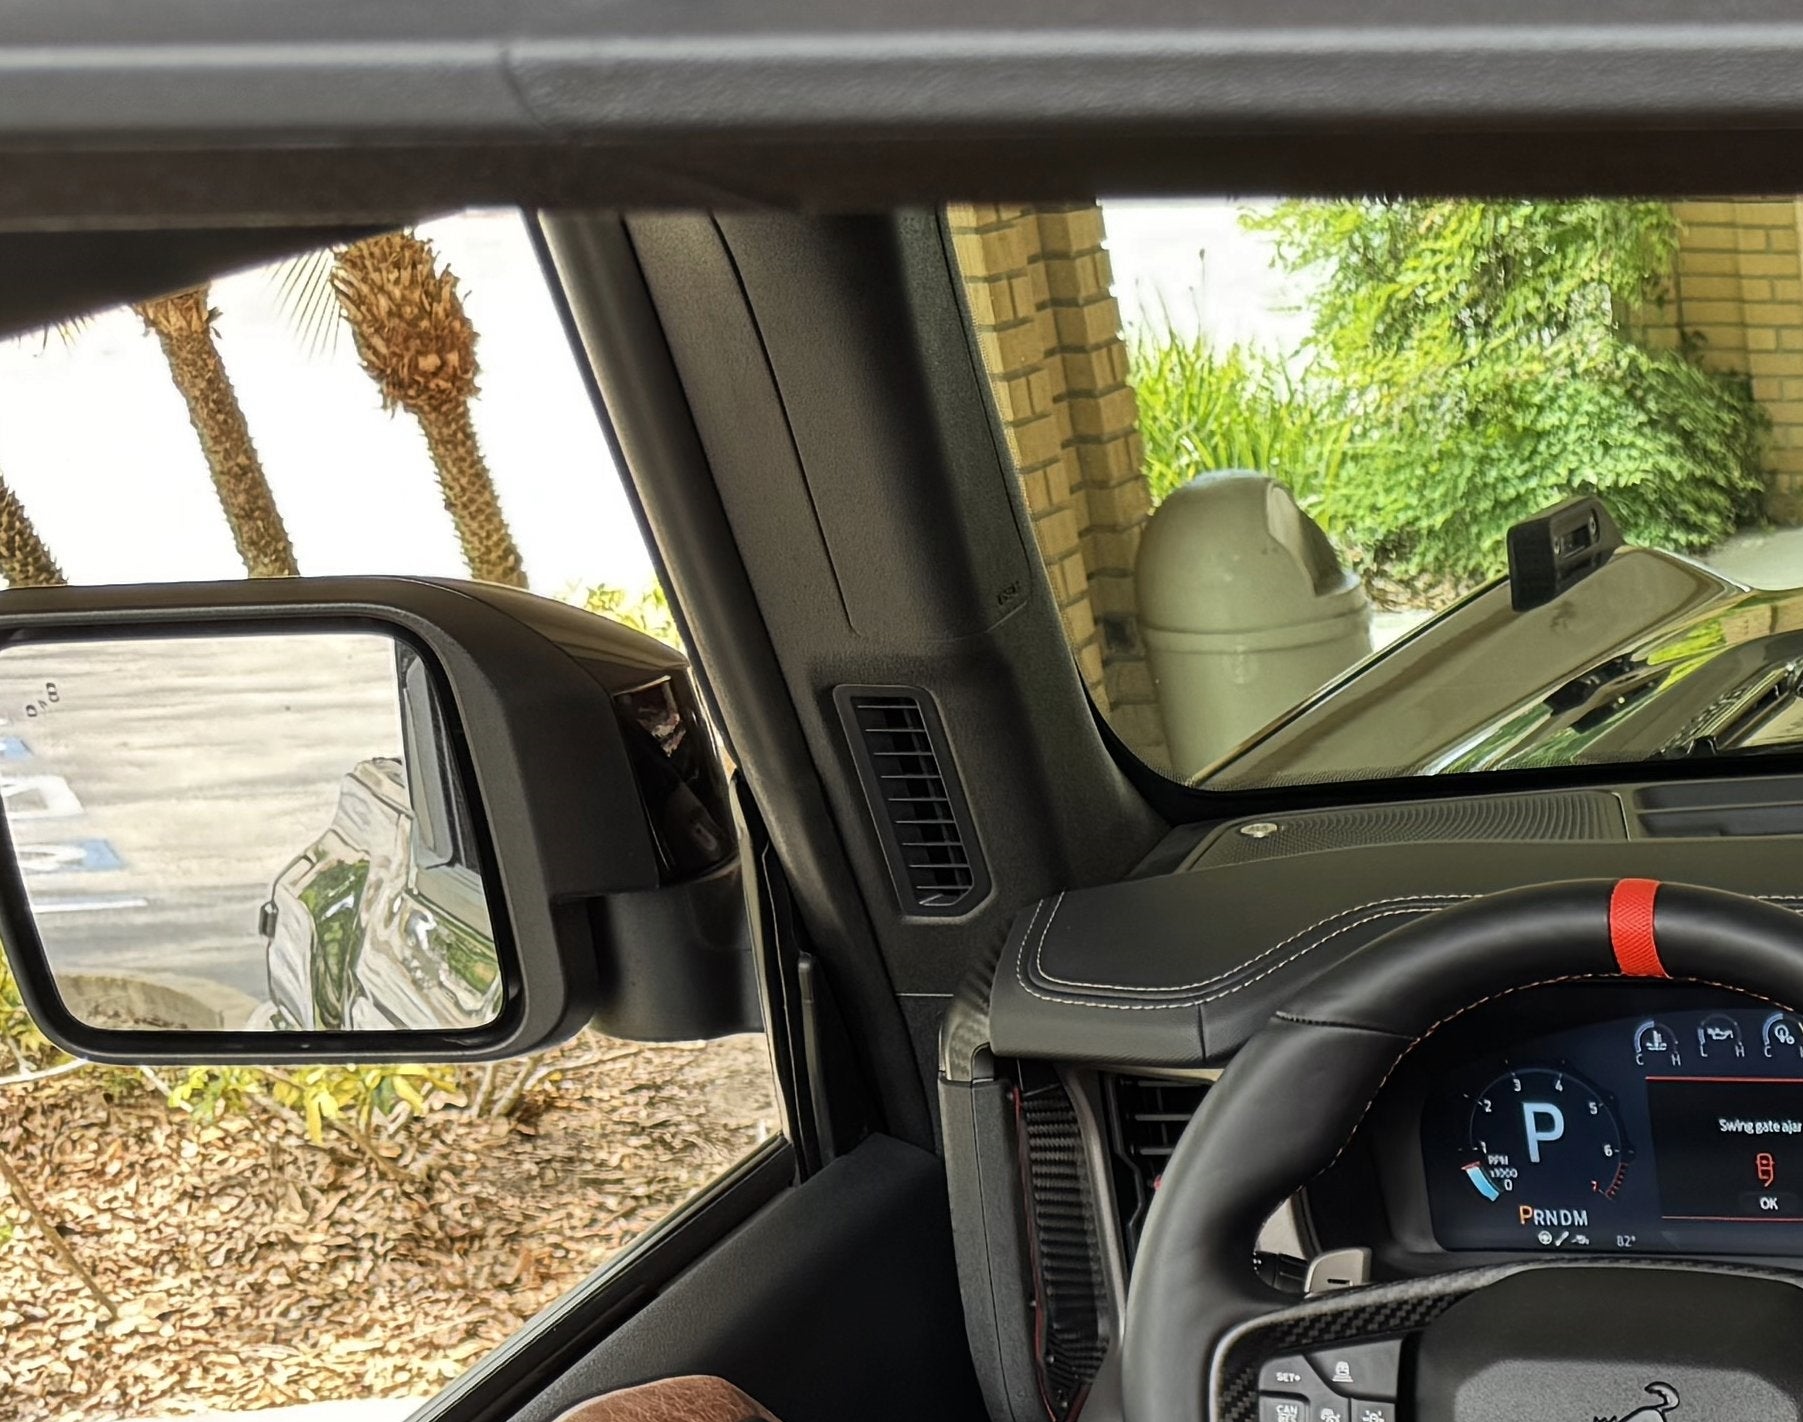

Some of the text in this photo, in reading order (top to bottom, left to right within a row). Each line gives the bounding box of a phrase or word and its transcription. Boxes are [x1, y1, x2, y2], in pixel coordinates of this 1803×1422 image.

[1736, 1047, 1745, 1058] H
[1764, 1047, 1772, 1058] C
[1635, 1054, 1645, 1066] C
[1671, 1054, 1681, 1066] H
[1513, 1079, 1522, 1092] 3
[1555, 1079, 1563, 1092] 4
[1484, 1100, 1492, 1113] 2
[1589, 1102, 1598, 1115] 5
[1522, 1102, 1565, 1162] P
[1719, 1119, 1802, 1134] Swing gate ajar
[1604, 1145, 1613, 1157] 6
[1504, 1179, 1513, 1191] 0
[1760, 1196, 1778, 1210] OK
[1276, 1405, 1298, 1415] CAN
